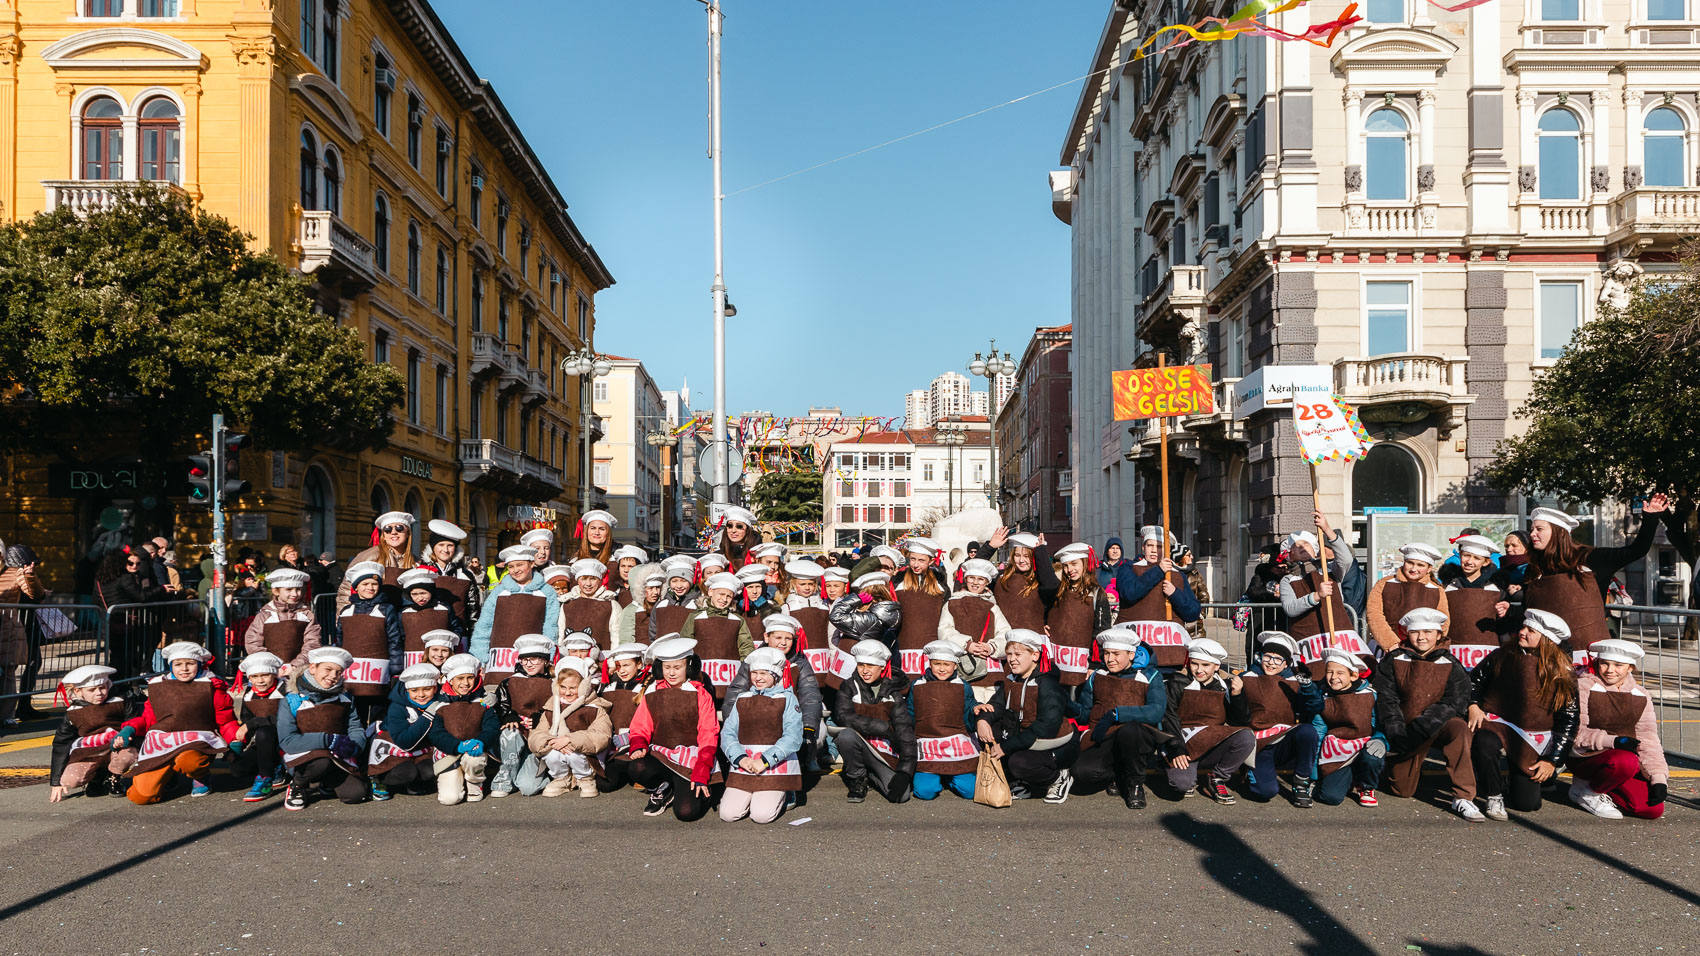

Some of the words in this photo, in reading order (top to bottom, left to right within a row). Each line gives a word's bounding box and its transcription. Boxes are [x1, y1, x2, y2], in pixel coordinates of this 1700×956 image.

[1128, 372, 1155, 393] OS
[1163, 368, 1192, 391] SE
[1138, 390, 1199, 415] GELSI
[1296, 403, 1334, 421] 28
[402, 456, 433, 479] DOUGLAS
